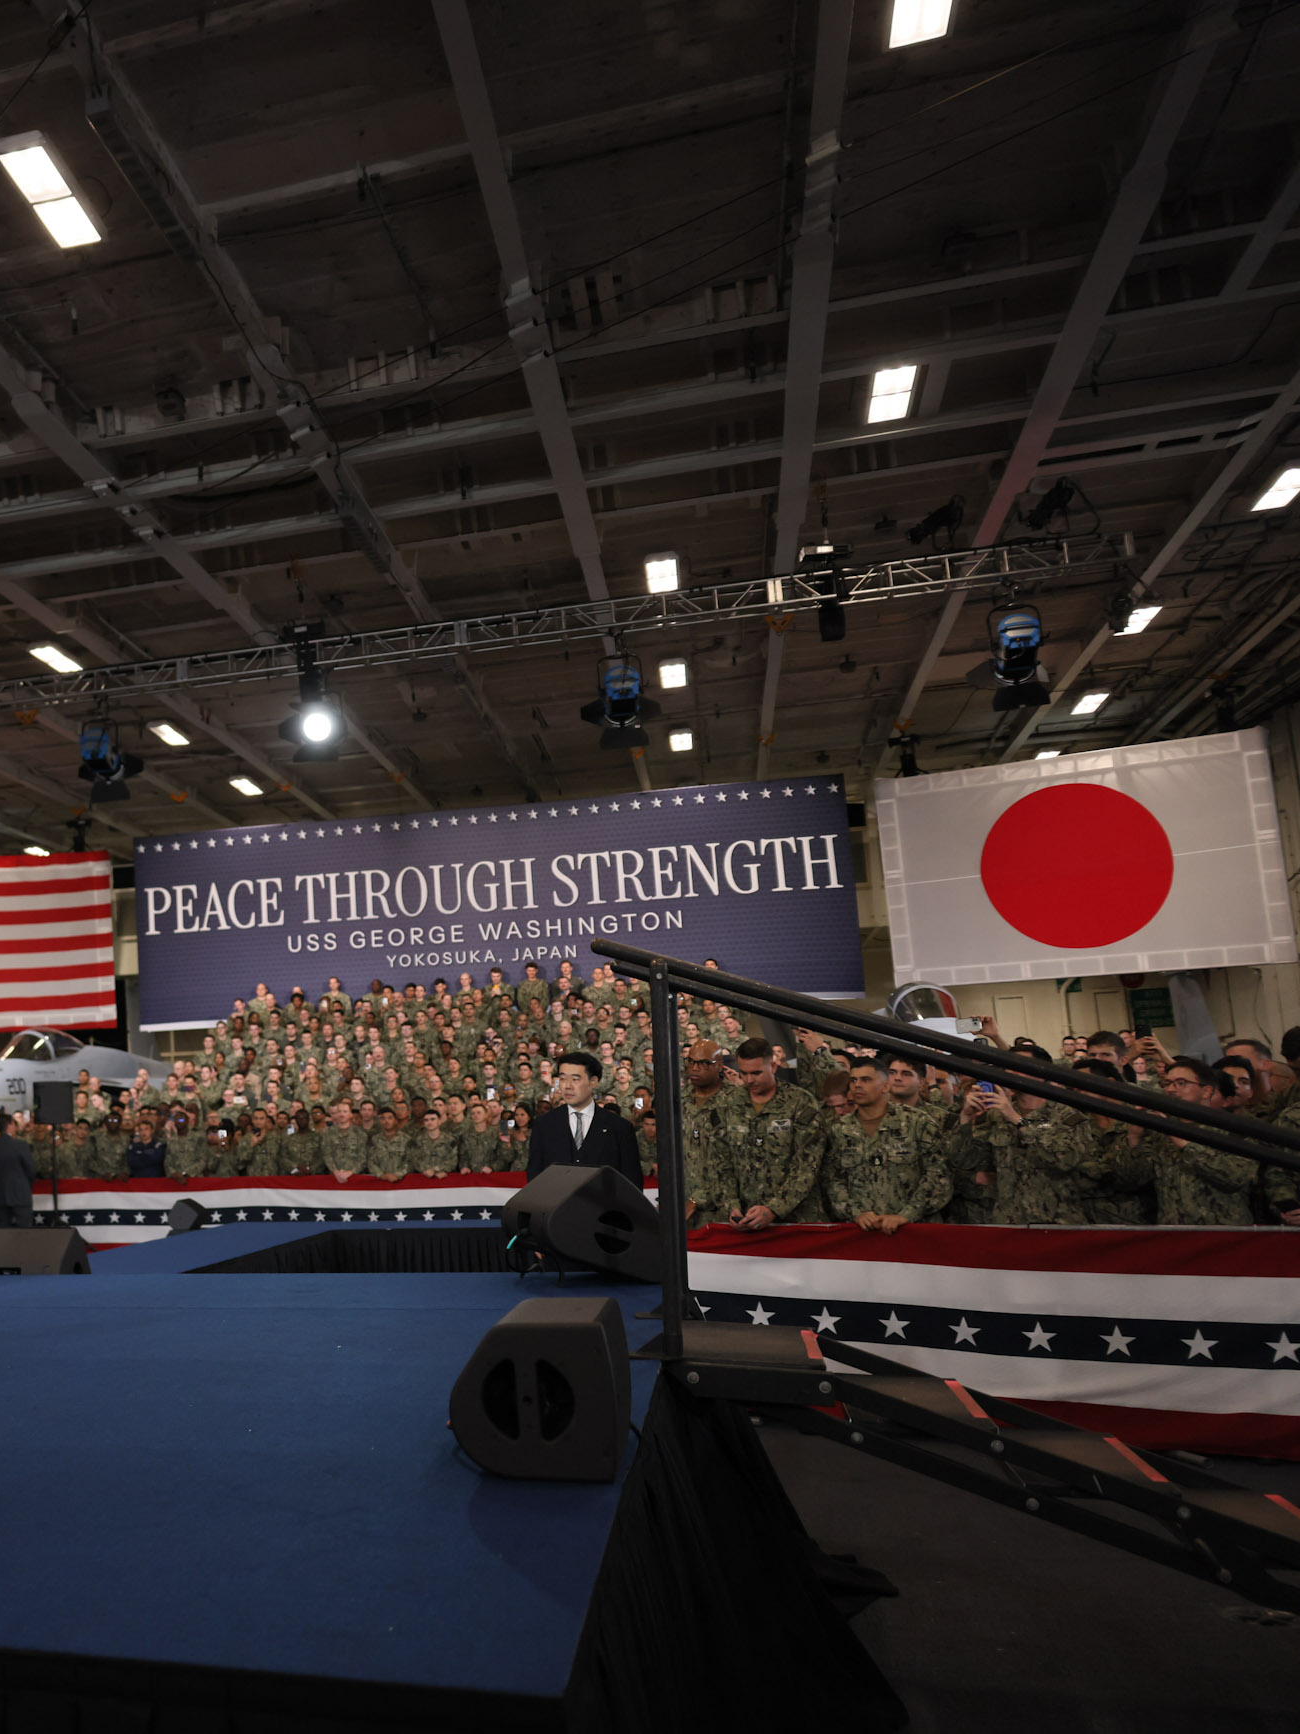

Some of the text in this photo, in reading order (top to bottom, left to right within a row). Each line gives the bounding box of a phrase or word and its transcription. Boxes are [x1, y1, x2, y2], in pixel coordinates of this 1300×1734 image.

[144, 834, 844, 936] PEACE THROUGH STRENGTH
[287, 909, 683, 953] USS GEORGE WASHINGTON
[386, 944, 577, 968] YOKOSUKA, JAPAN
[6, 1078, 26, 1095] 200
